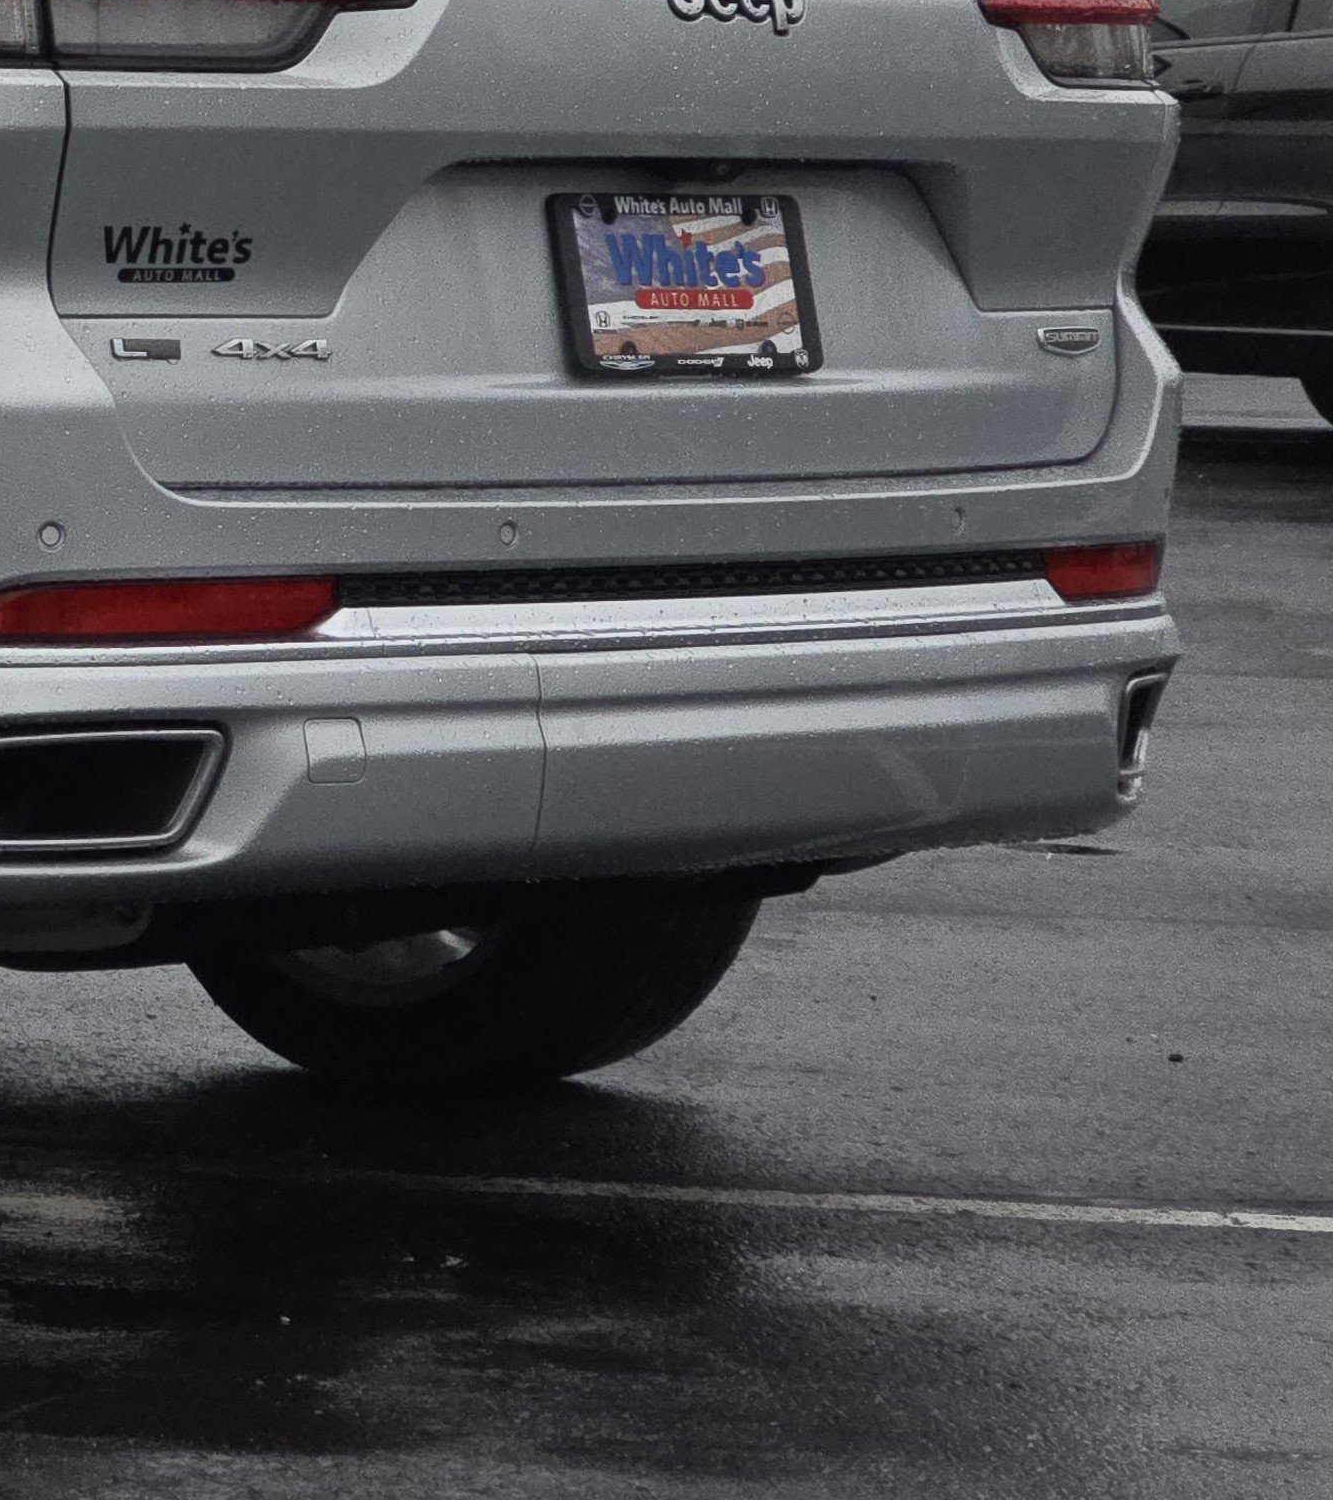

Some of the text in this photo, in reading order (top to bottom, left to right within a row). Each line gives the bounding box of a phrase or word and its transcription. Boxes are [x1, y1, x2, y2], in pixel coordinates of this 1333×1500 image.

[614, 195, 743, 215] White's Auto Mall
[104, 222, 253, 265] White's
[605, 233, 766, 287] White's
[133, 269, 222, 282] AUTO MALL
[650, 292, 739, 307] AUTO MALL
[746, 353, 774, 370] Jeep
